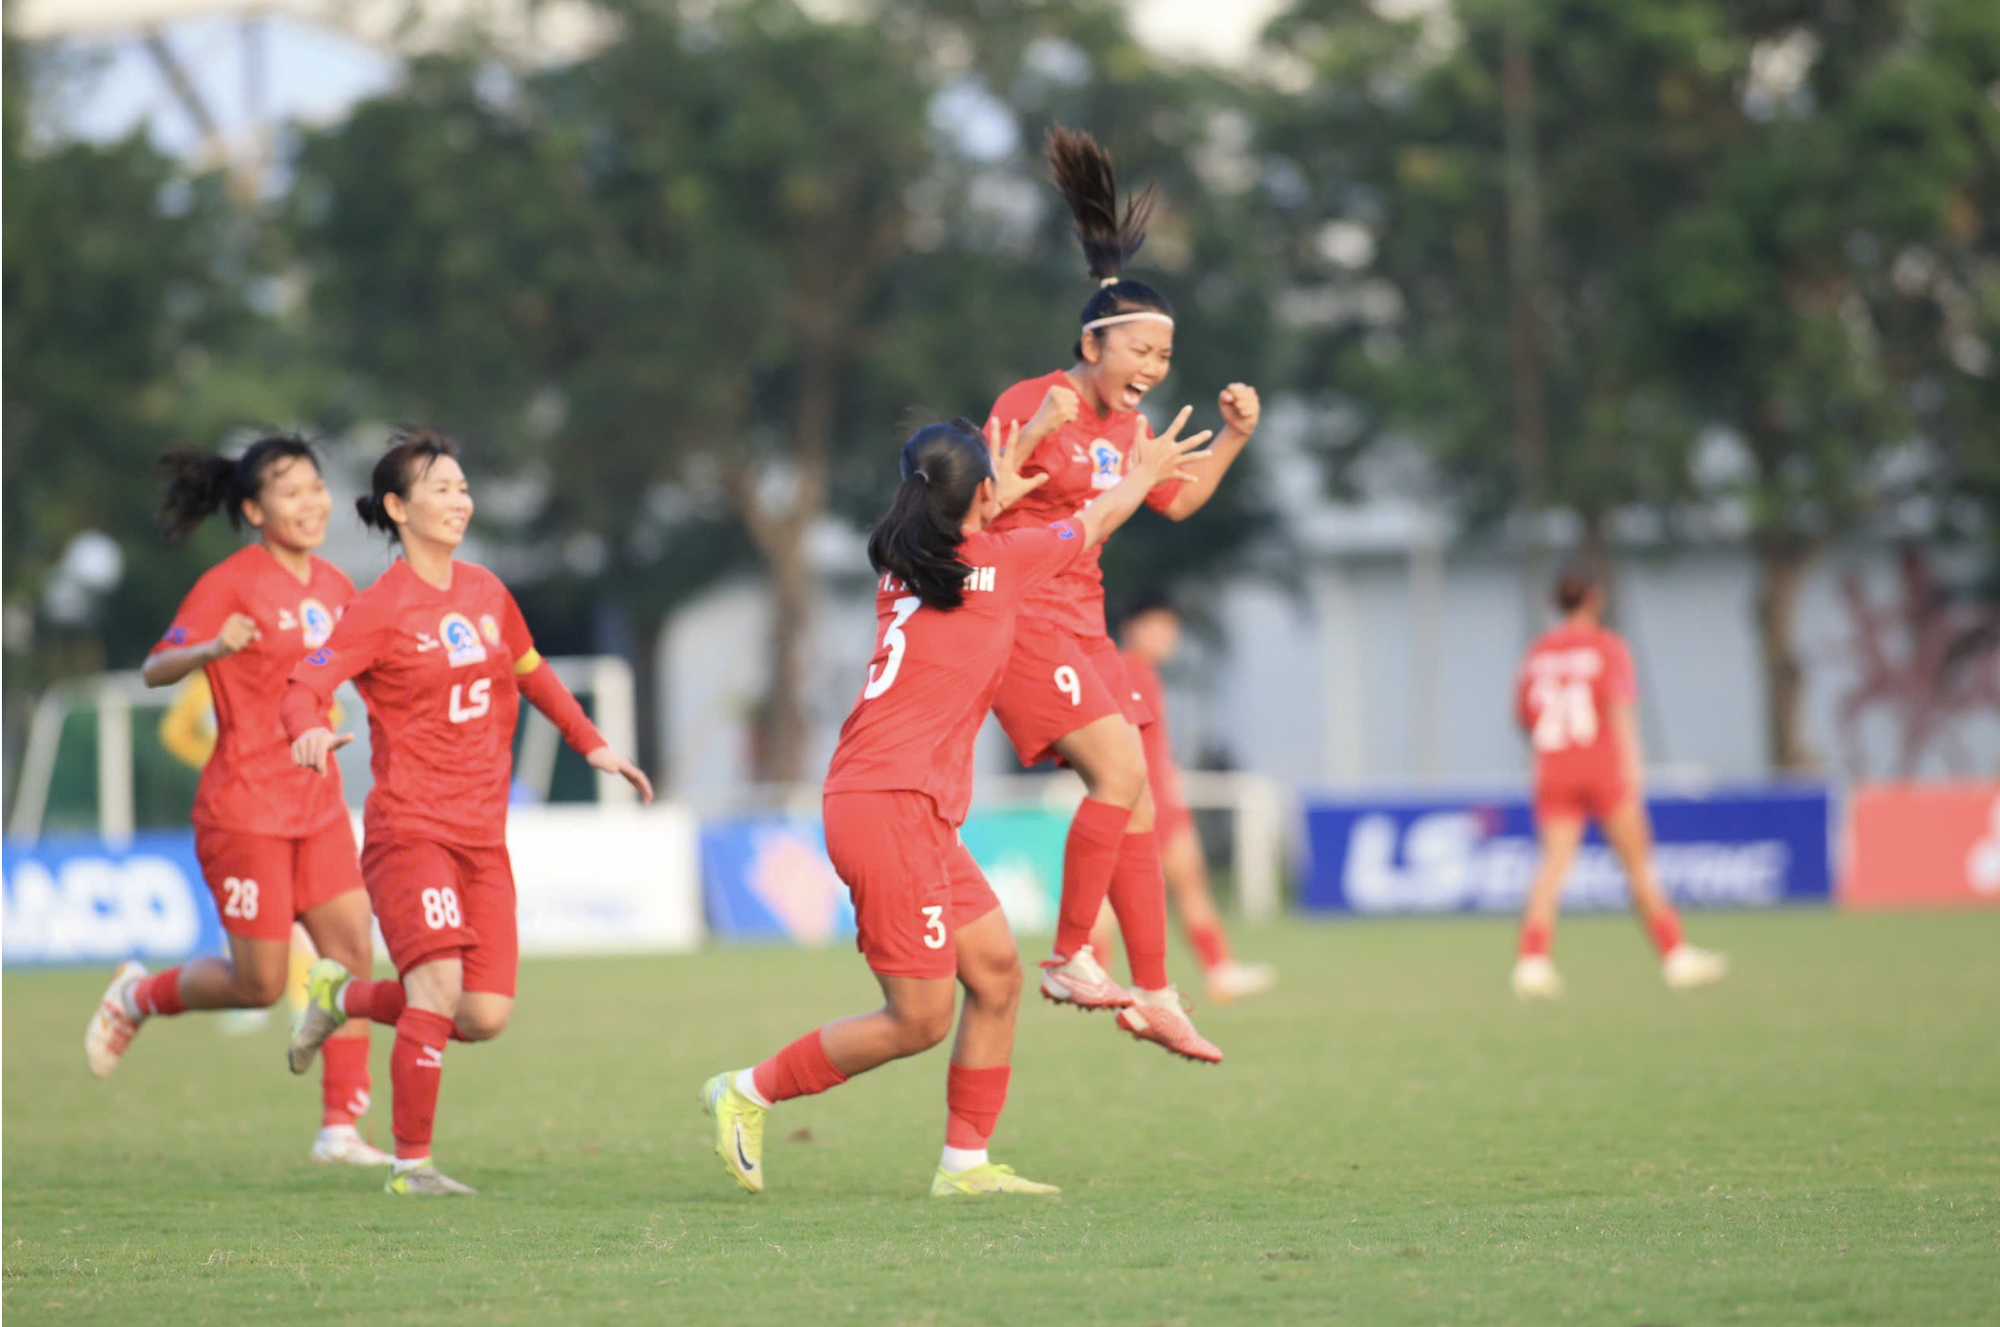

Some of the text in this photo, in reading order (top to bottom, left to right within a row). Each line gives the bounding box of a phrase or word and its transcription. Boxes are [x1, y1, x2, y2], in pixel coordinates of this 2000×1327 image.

[863, 595, 922, 700] 3
[448, 677, 492, 724] LS
[1053, 664, 1081, 706] 9
[223, 876, 259, 920] 28
[421, 886, 461, 930] 88
[921, 905, 946, 949] 3
